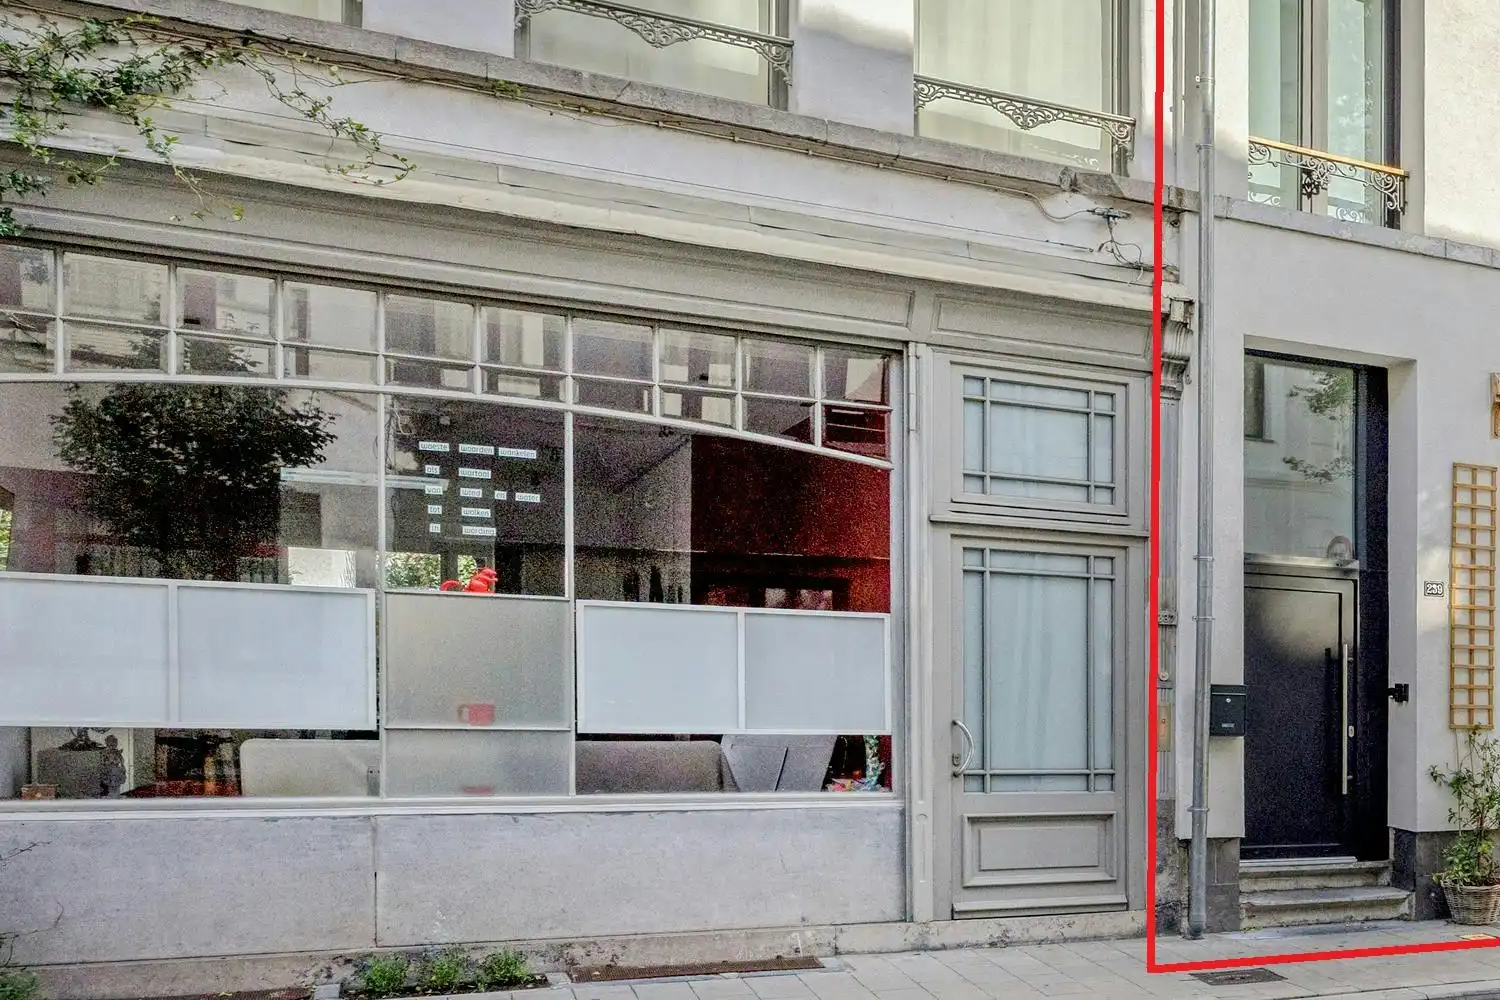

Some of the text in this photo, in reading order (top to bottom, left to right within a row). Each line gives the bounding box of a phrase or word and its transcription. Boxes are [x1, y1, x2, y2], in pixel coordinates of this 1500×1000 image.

[421, 442, 536, 458] woeste woorden wankelen
[462, 488, 481, 497] wind
[517, 494, 539, 502] water
[429, 506, 490, 517] tot wolken
[464, 527, 495, 536] wording
[1426, 583, 1443, 595] 239
